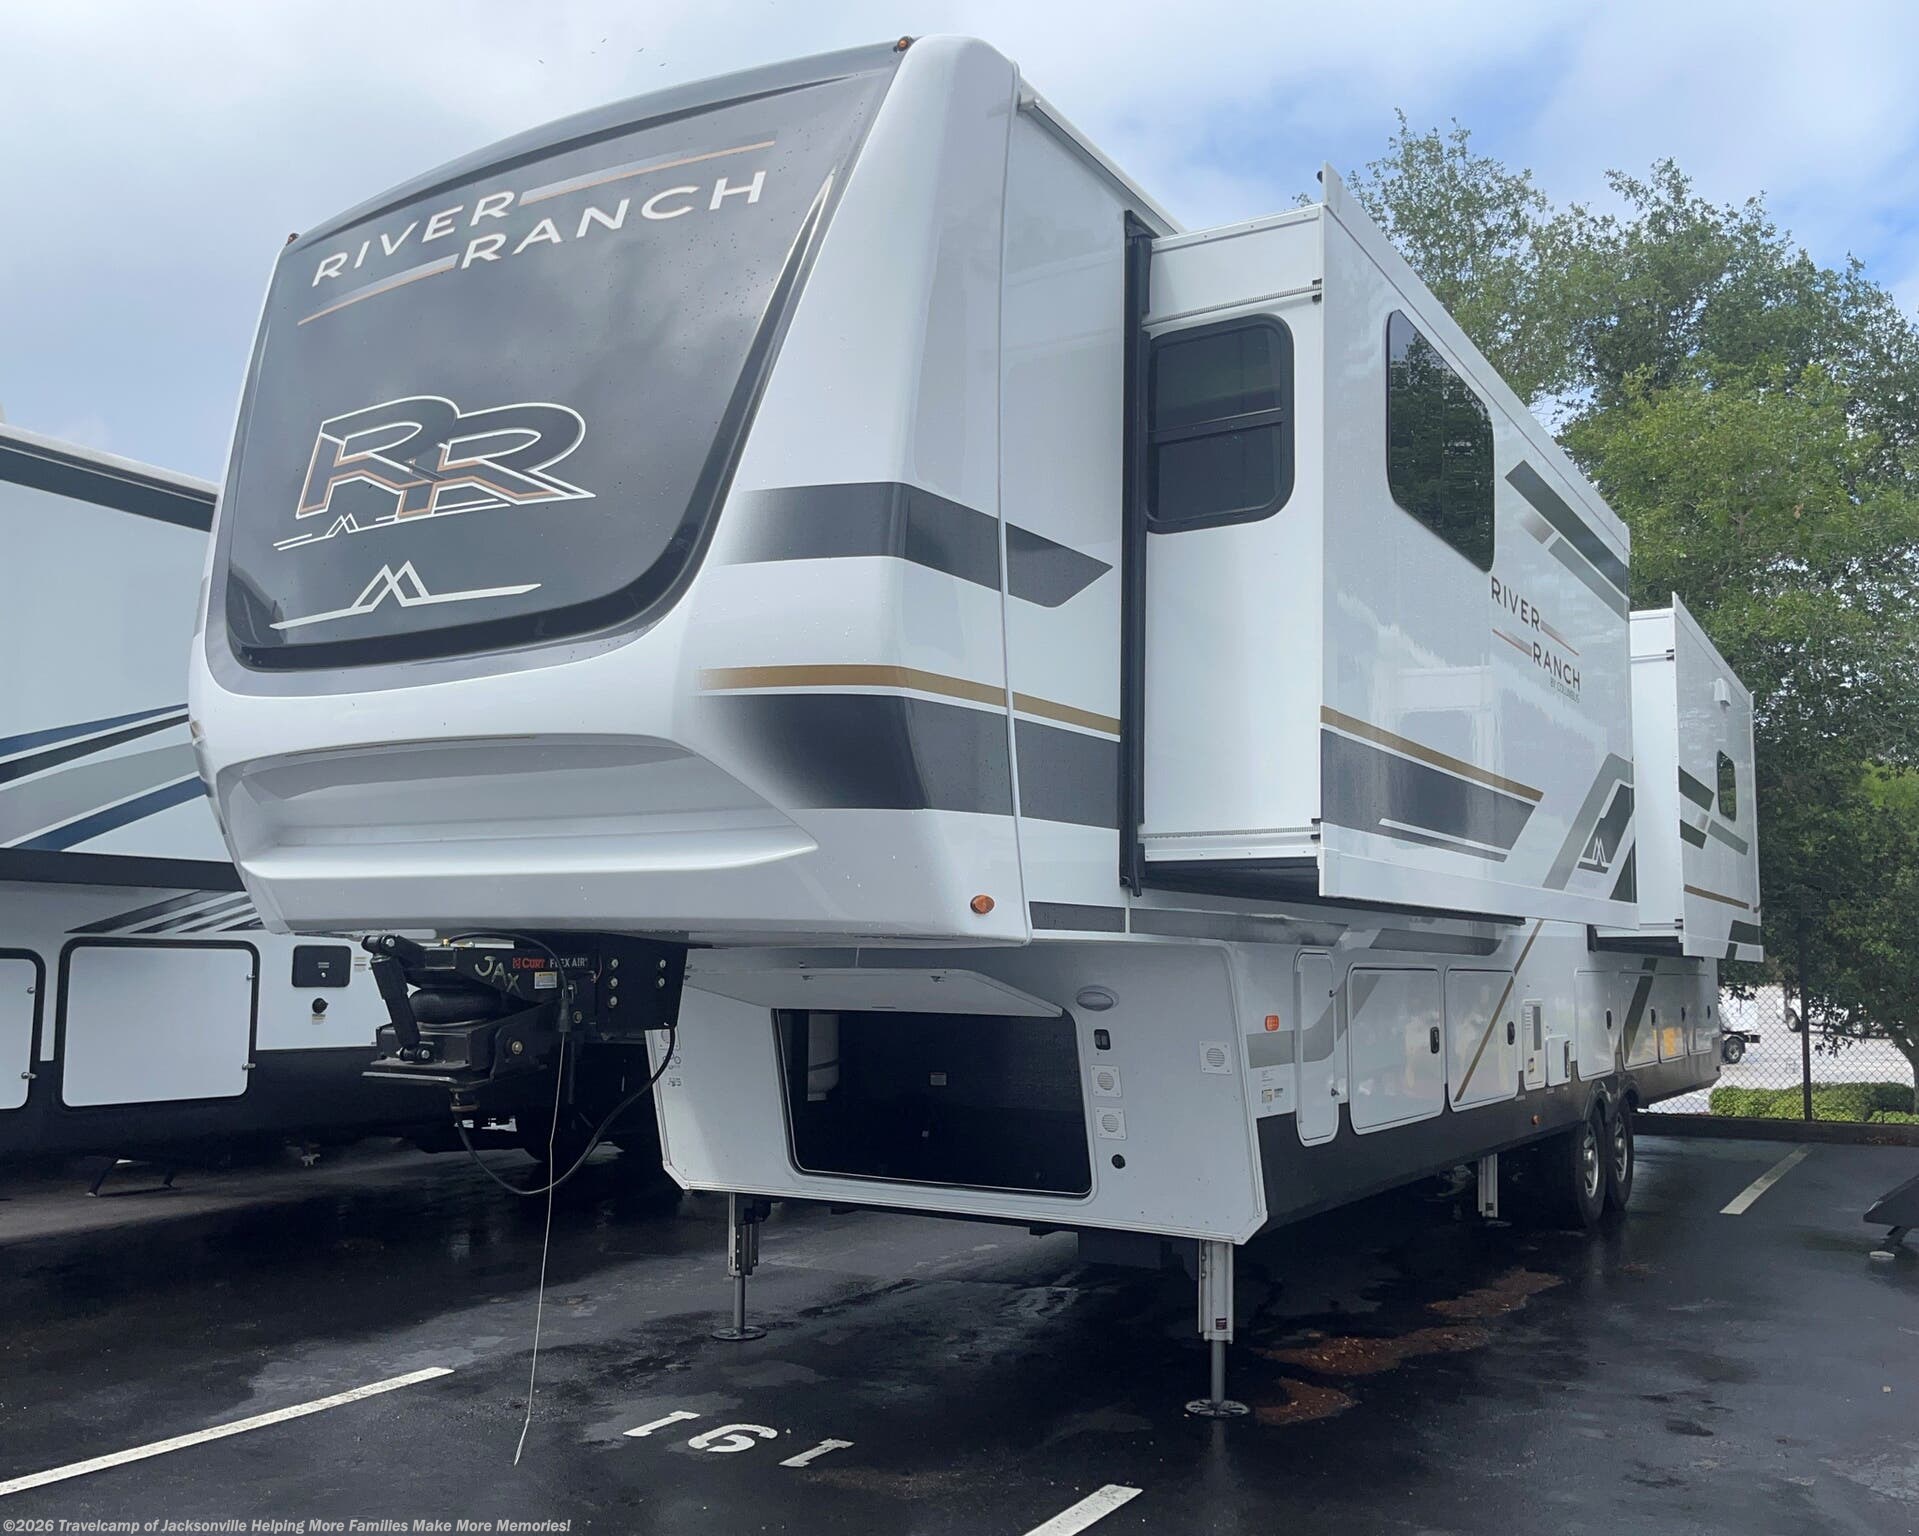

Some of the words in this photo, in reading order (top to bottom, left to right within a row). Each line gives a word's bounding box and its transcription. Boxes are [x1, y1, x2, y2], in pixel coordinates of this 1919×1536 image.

[312, 190, 515, 287] RIVER
[461, 171, 767, 270] RANCH
[1491, 575, 1540, 632] RIVER
[1533, 641, 1580, 692] RANCH
[474, 955, 521, 993] JAX
[522, 957, 545, 968] CURT
